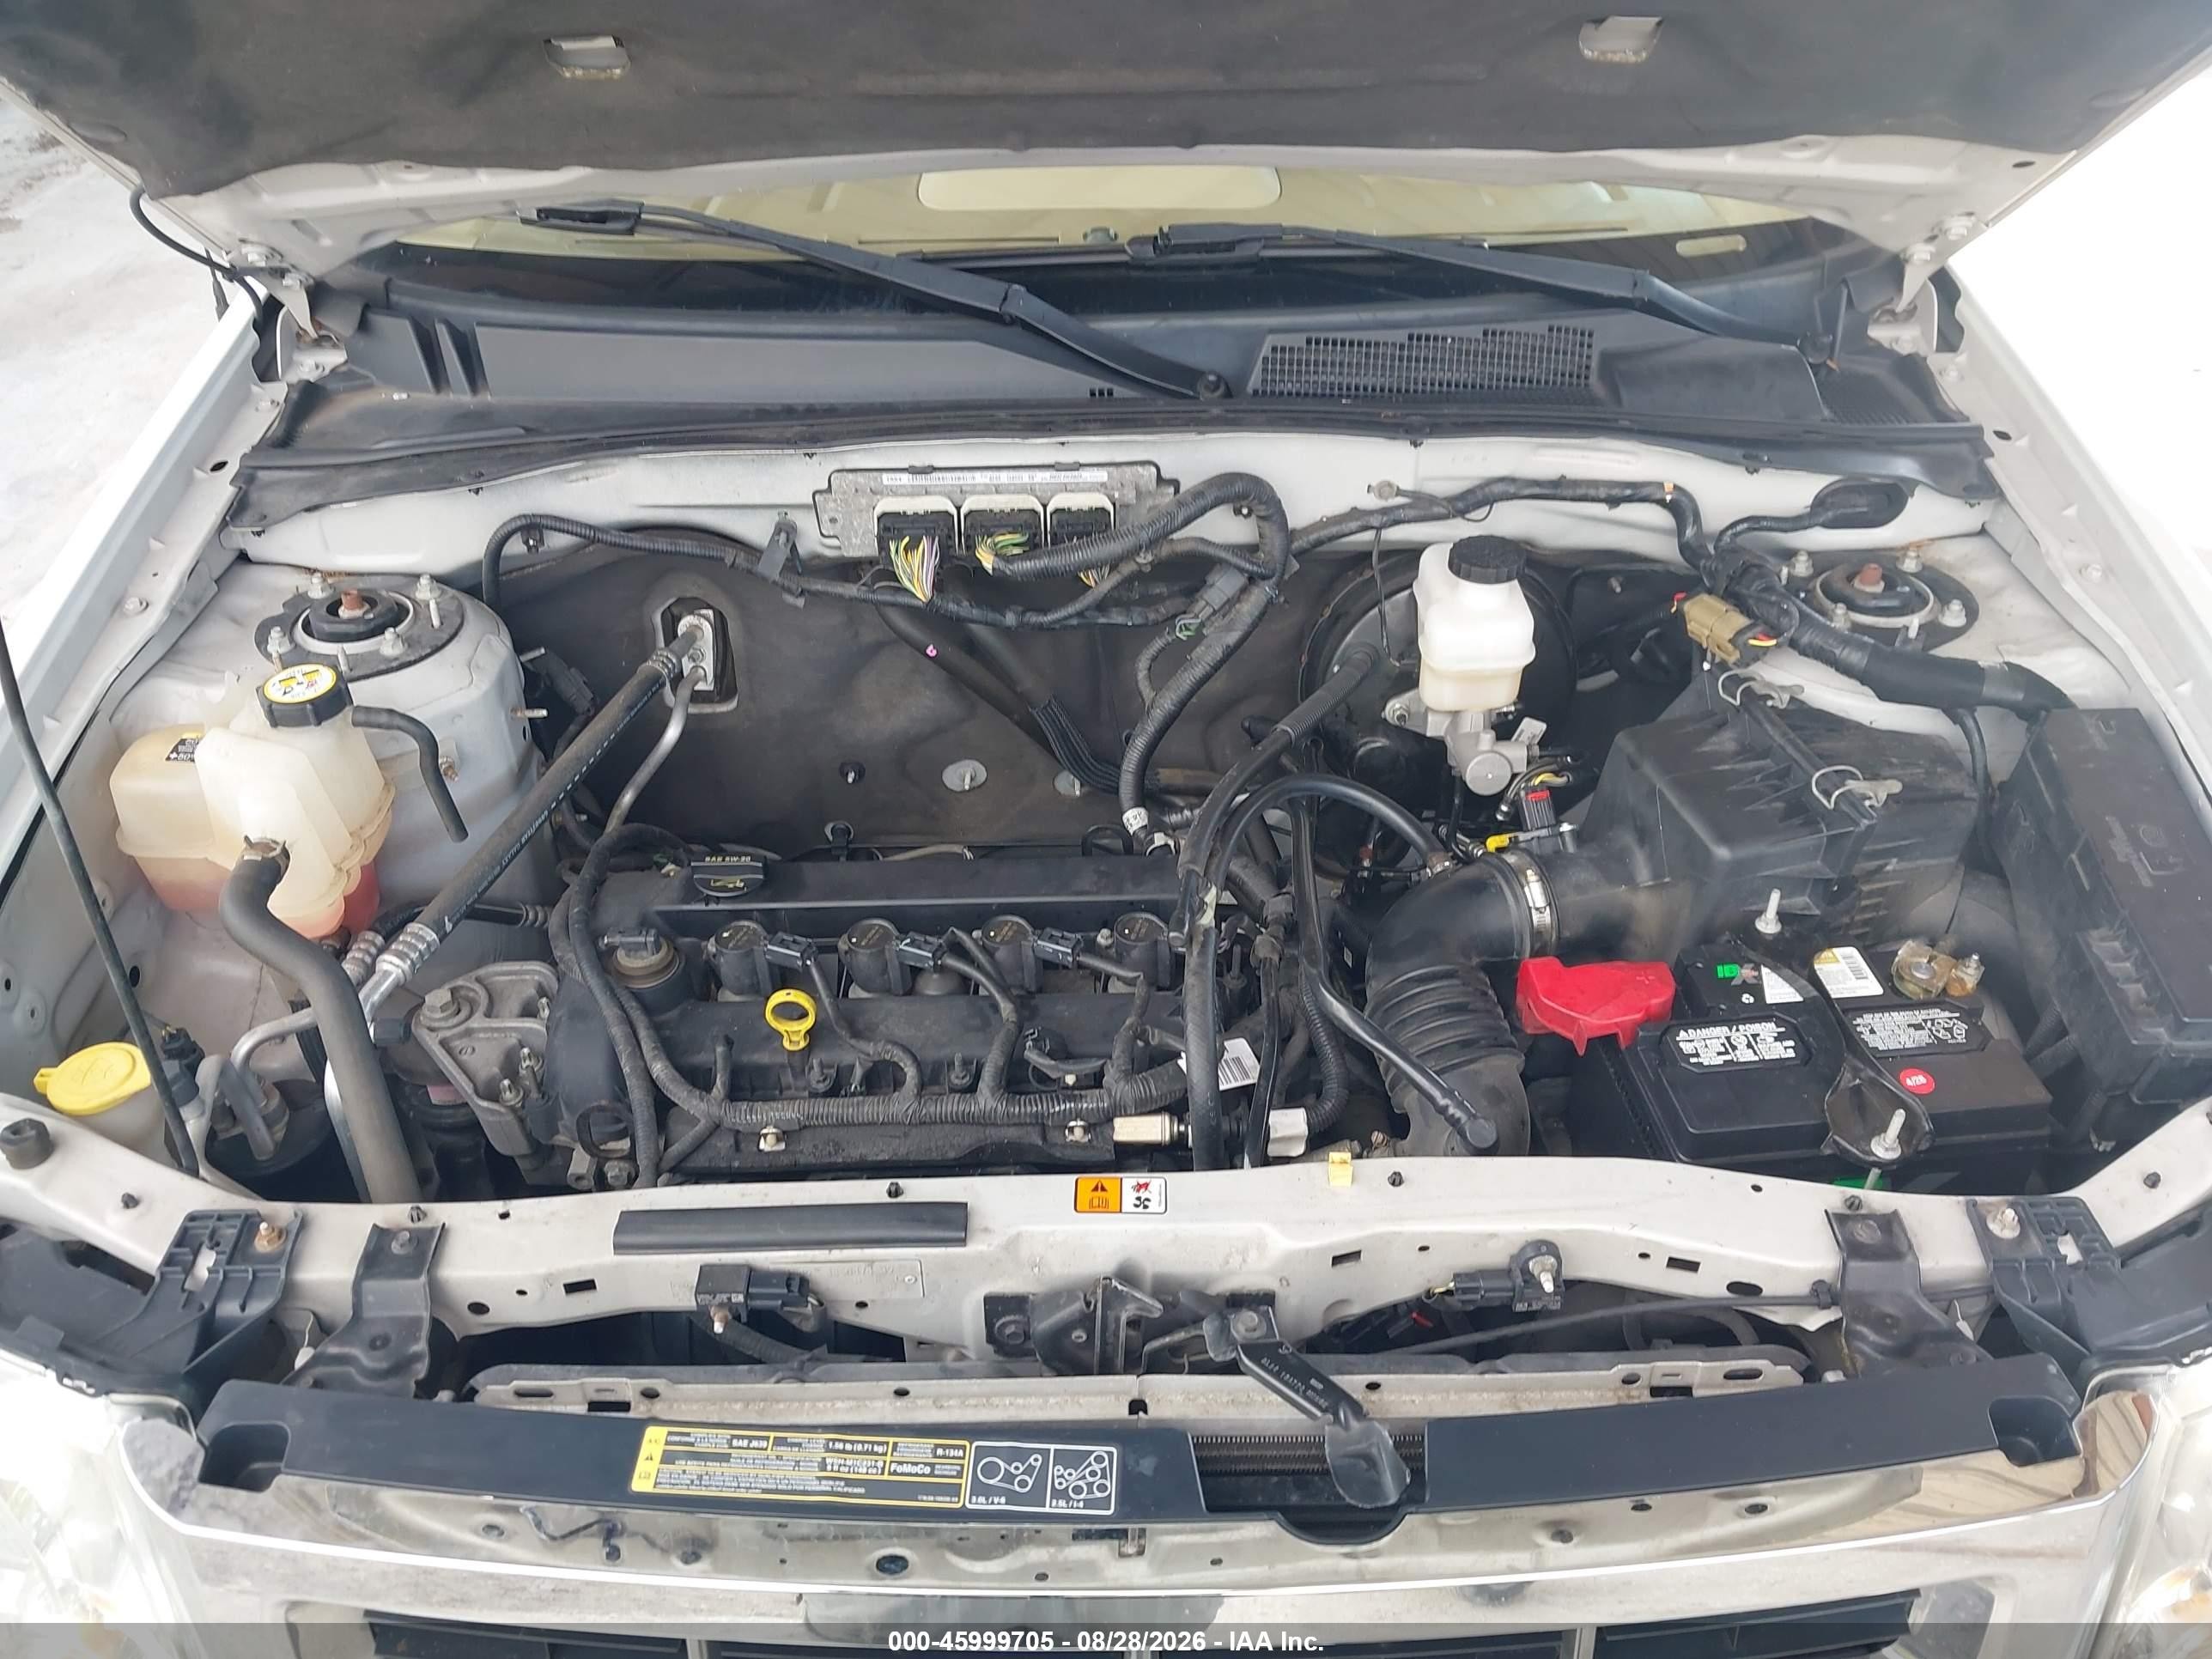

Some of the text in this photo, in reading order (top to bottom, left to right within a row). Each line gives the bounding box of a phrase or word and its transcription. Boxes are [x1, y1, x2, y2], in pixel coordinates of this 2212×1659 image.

[1687, 1025, 1729, 1037] DANGER
[1740, 1022, 1777, 1033] POISON
[732, 1438, 749, 1448] SAE
[936, 1448, 964, 1457] R-134A
[890, 1462, 931, 1475] FoMoCo
